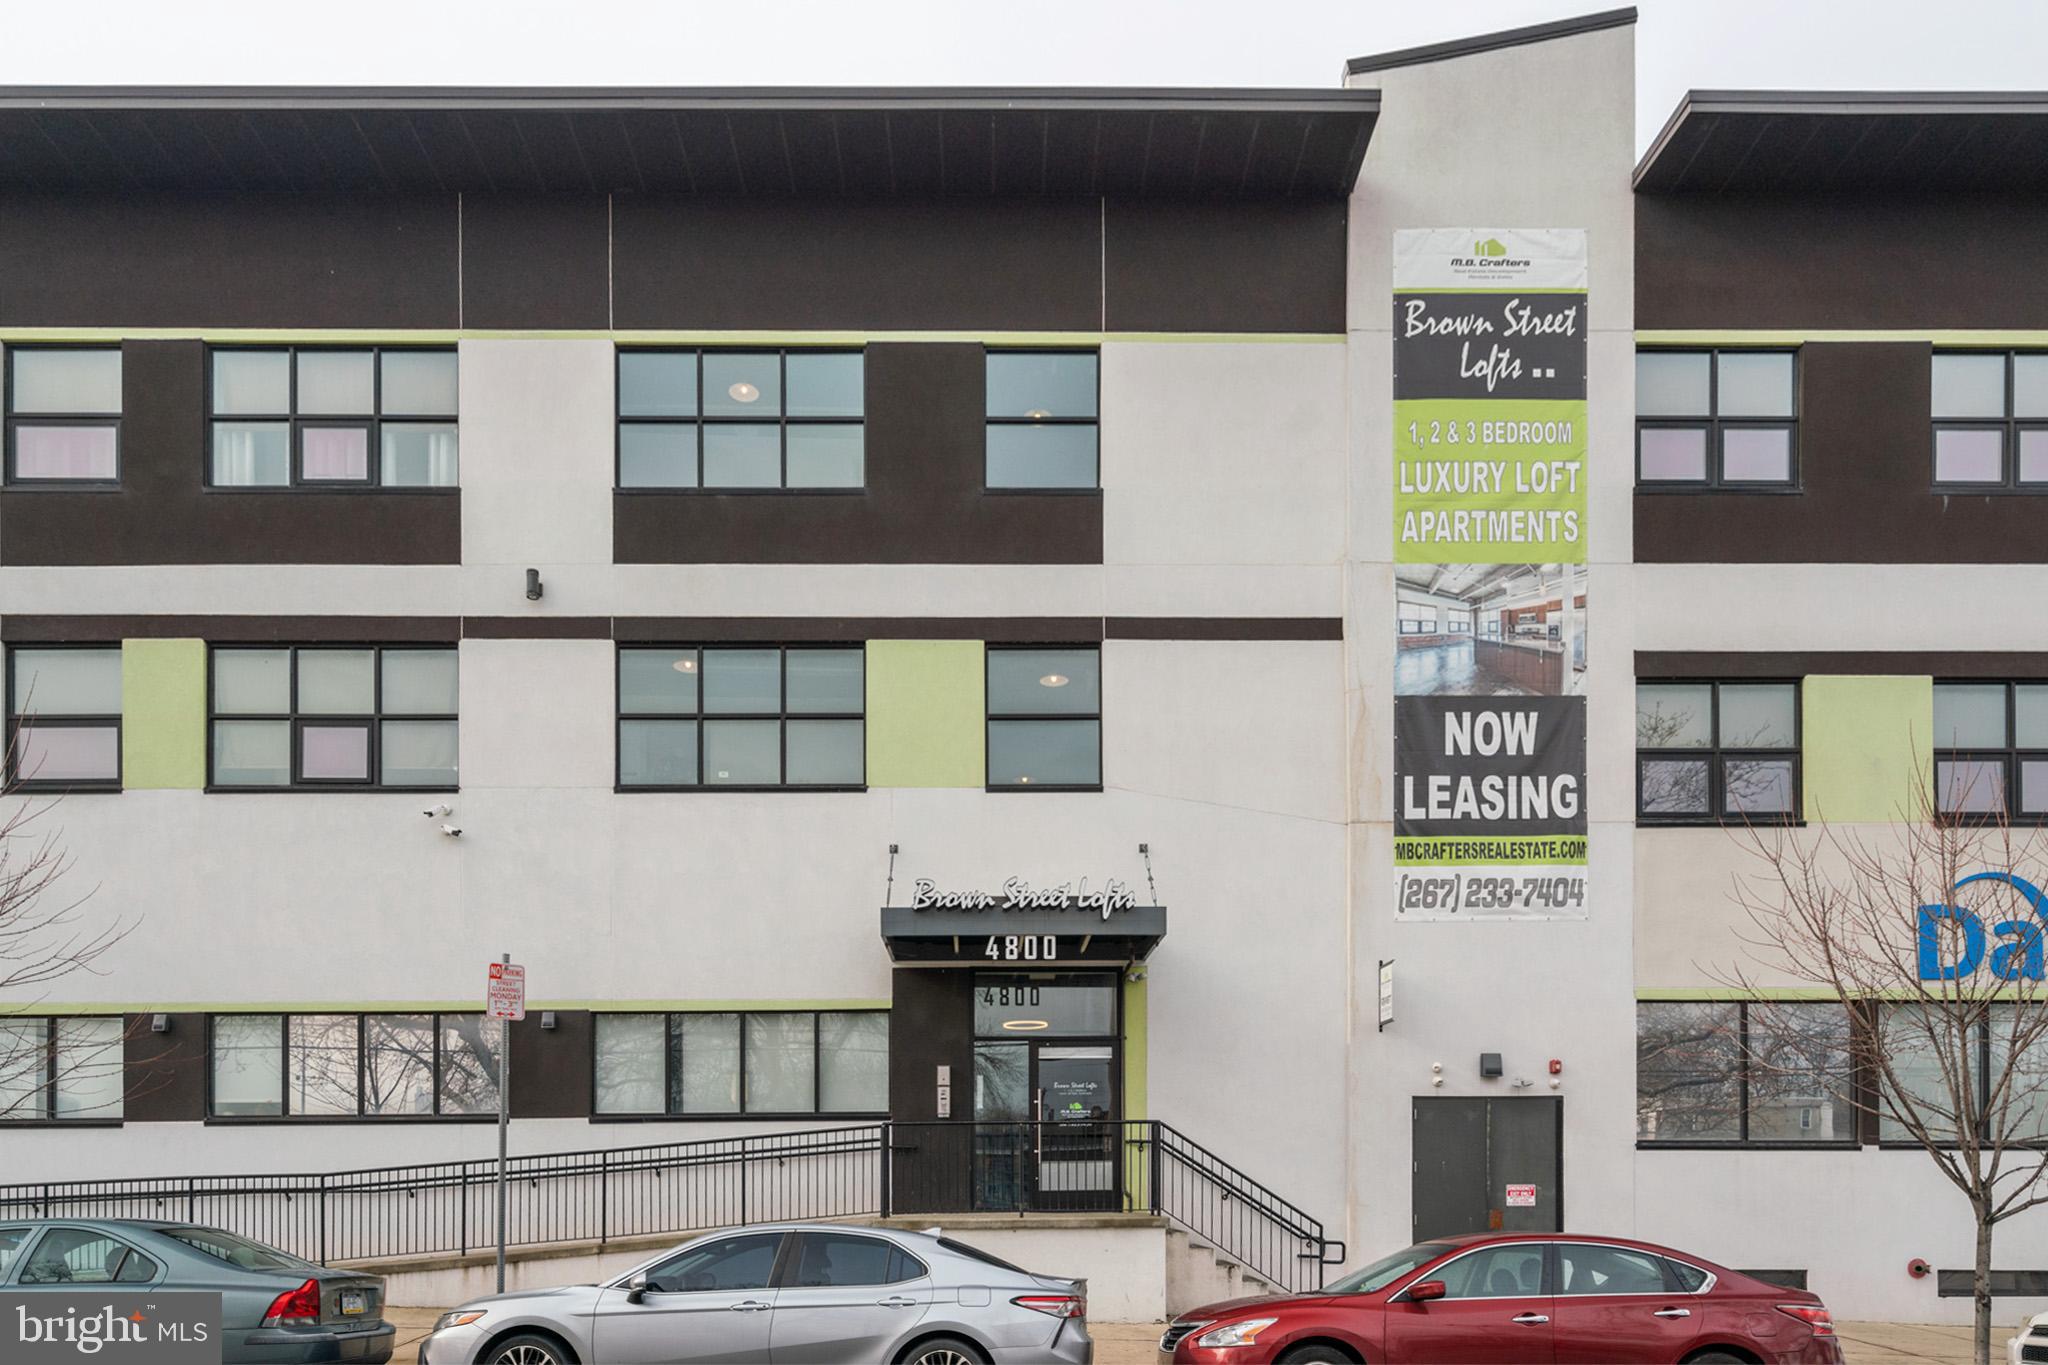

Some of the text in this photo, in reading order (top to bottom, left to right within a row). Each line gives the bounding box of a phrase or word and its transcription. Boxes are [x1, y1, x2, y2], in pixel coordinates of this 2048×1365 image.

[1479, 258, 1531, 267] Crafters
[1404, 298, 1577, 338] Brown Street
[1460, 341, 1523, 393] Lofts
[1408, 421, 1572, 449] 1, 2 & 3 BEDROOM
[1400, 461, 1581, 494] LUXURY LOFT
[1401, 510, 1579, 543] APARTMENTS
[1444, 711, 1538, 756] NOW
[1403, 774, 1578, 820] LEASING
[1396, 841, 1586, 860] MBCRAFTERSREALESTATE.COM
[913, 876, 1137, 921] Brown Street Lofts
[1398, 873, 1584, 914] (267) 233-7404
[985, 935, 1057, 960] 4800
[490, 965, 523, 978] NO PARKING
[490, 992, 521, 1001] MONDAY
[984, 986, 1040, 1006] 4800
